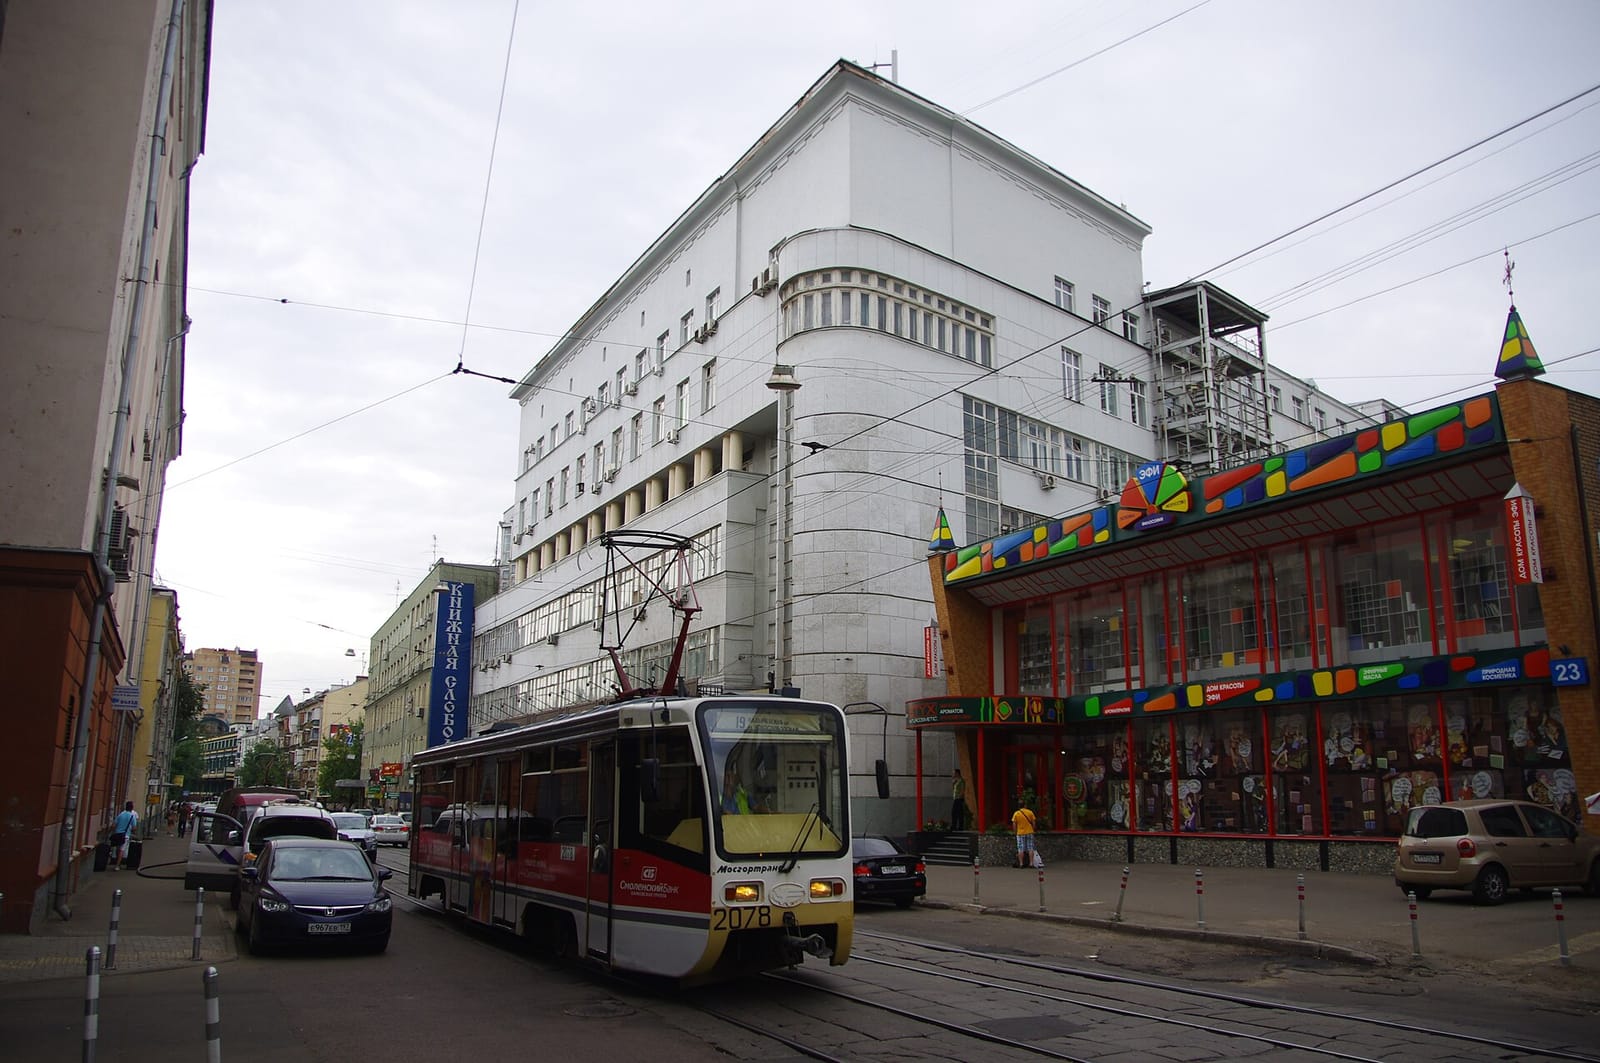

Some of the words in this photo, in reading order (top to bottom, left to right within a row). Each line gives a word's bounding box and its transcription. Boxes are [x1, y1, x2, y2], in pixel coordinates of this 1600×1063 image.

[1138, 465, 1160, 480] ЭФИ
[1510, 499, 1519, 518] ЭФИ
[1513, 520, 1524, 557] КРАСОТЫ
[1528, 519, 1537, 556] КРАСОТЫ
[1517, 558, 1527, 579] ДОМ
[1532, 558, 1540, 579] ДОМ
[445, 582, 464, 670] КНИЖНАЯ
[1481, 666, 1516, 675] ПРИРОДНАЯ
[1555, 663, 1581, 681] 23
[1206, 684, 1219, 692] ДОМ
[1220, 681, 1245, 691] КРАСОТЫ
[1206, 693, 1221, 701] ЭФИ
[736, 716, 746, 729] 19
[714, 906, 771, 931] 2078
